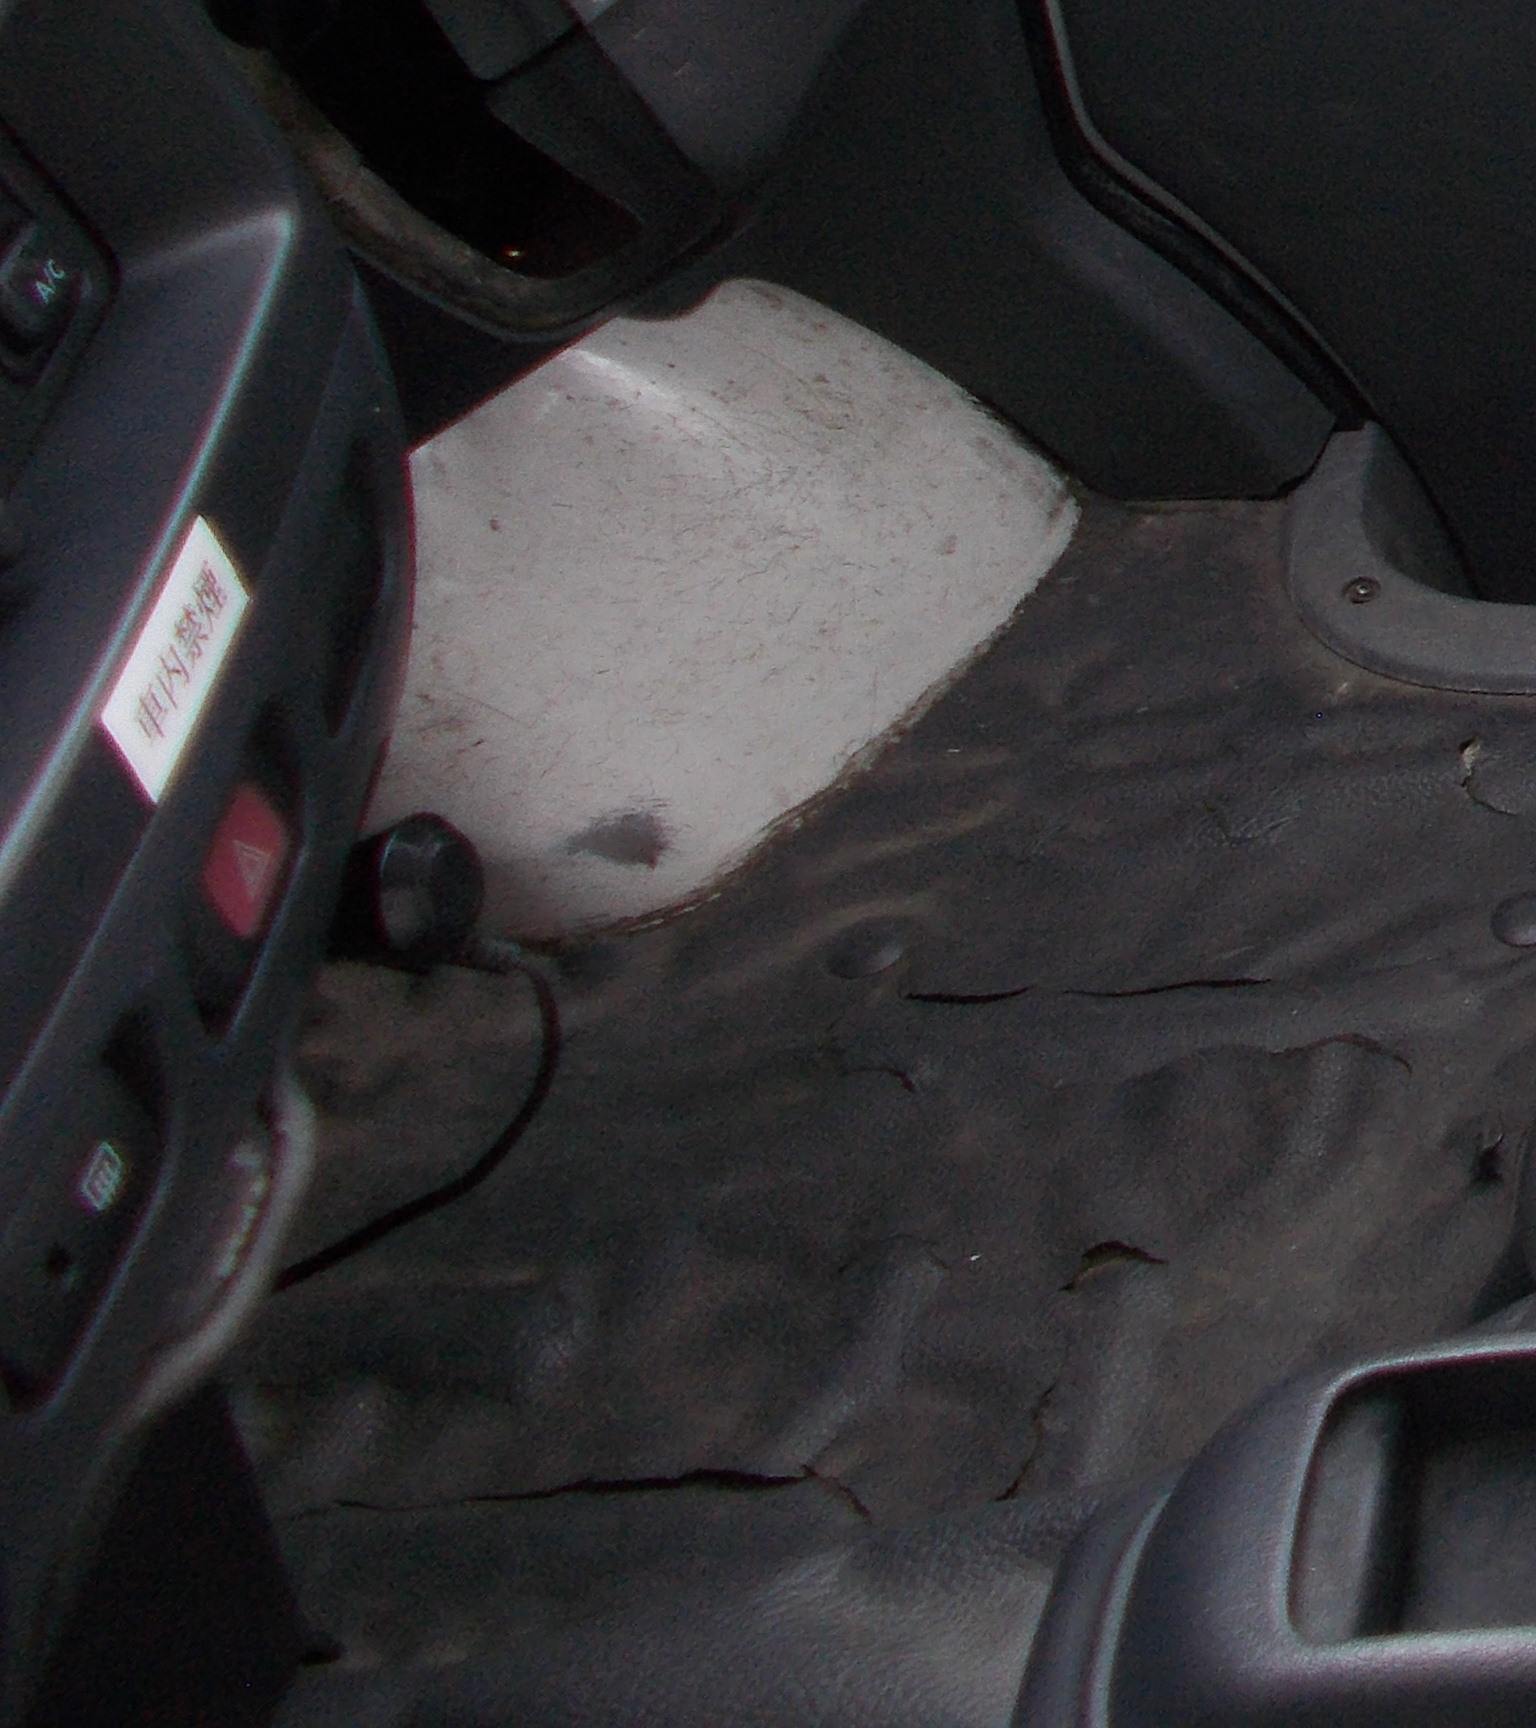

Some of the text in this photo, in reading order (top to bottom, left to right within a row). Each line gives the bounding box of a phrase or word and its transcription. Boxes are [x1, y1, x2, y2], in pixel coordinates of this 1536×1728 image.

[35, 258, 66, 305] A/C
[138, 560, 227, 740] 車内禁煙
